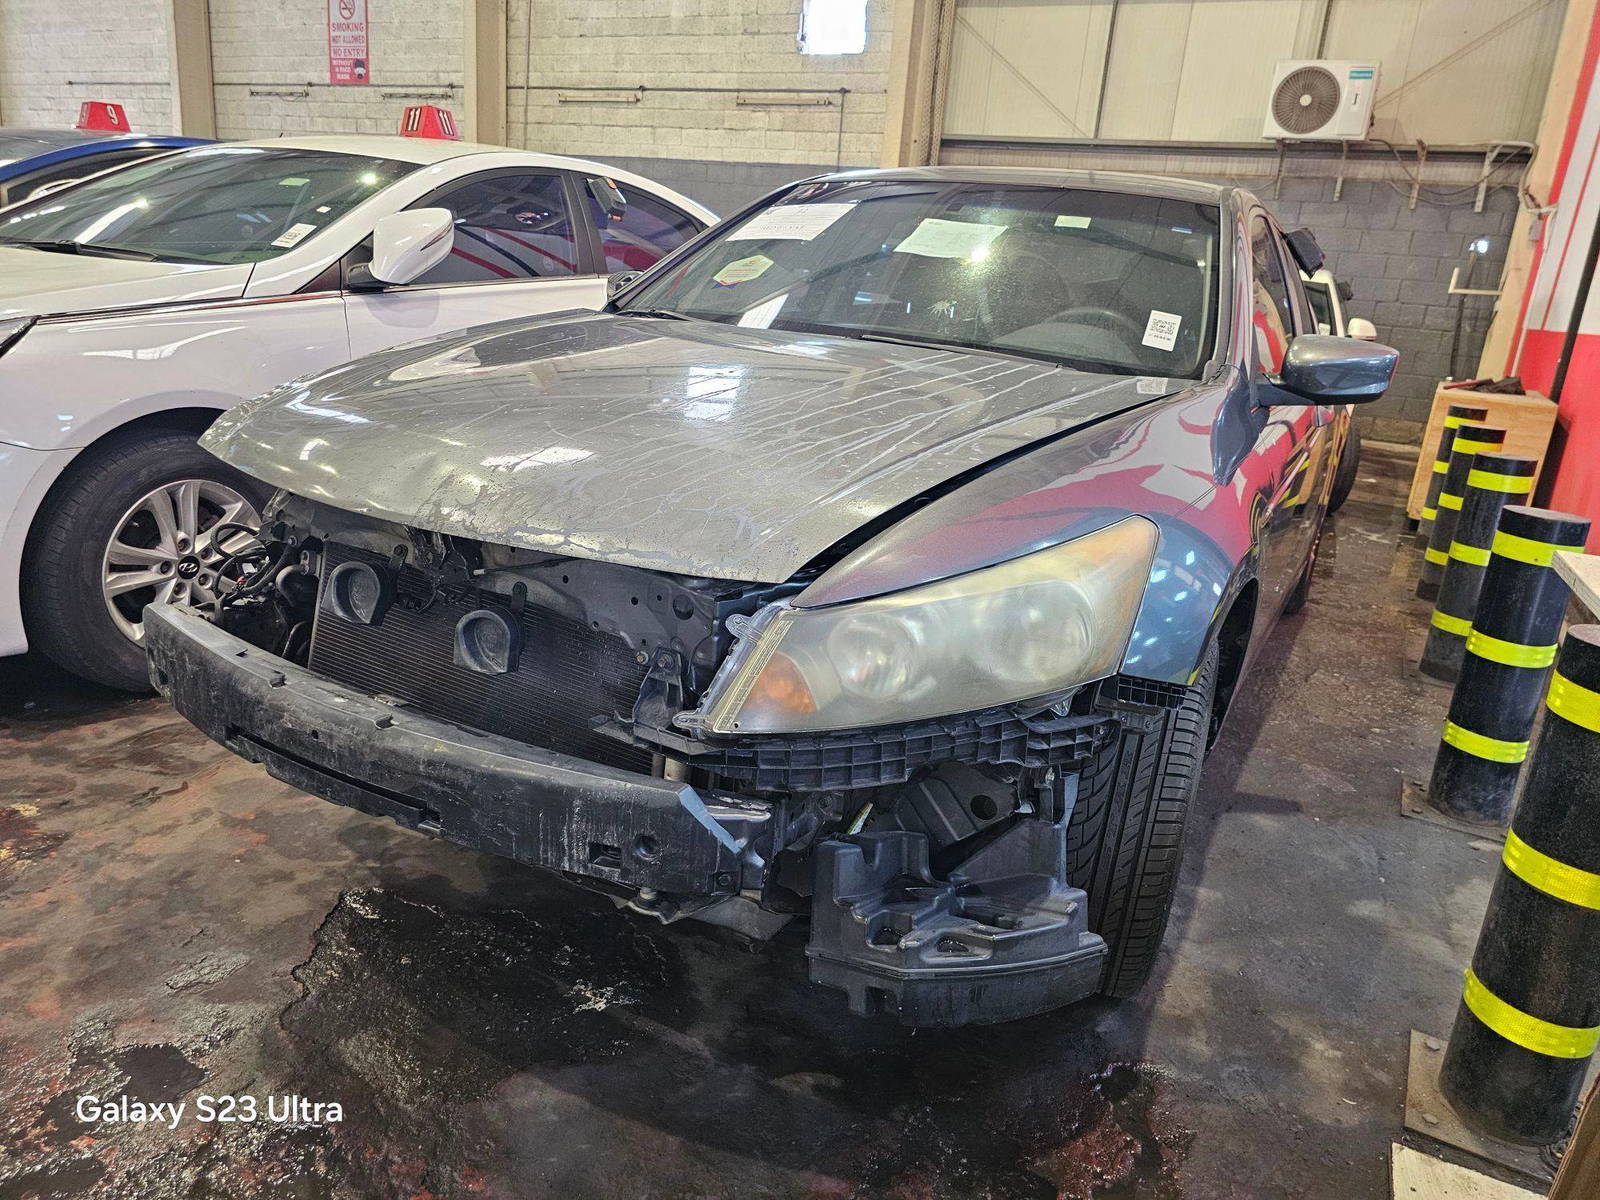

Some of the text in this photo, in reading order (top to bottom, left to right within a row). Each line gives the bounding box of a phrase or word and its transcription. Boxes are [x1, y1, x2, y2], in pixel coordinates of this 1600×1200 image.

[332, 22, 364, 32] SMOKING
[333, 48, 365, 57] NO ENTRY
[106, 104, 119, 126] 9
[407, 107, 421, 131] 11
[439, 110, 454, 136] 11
